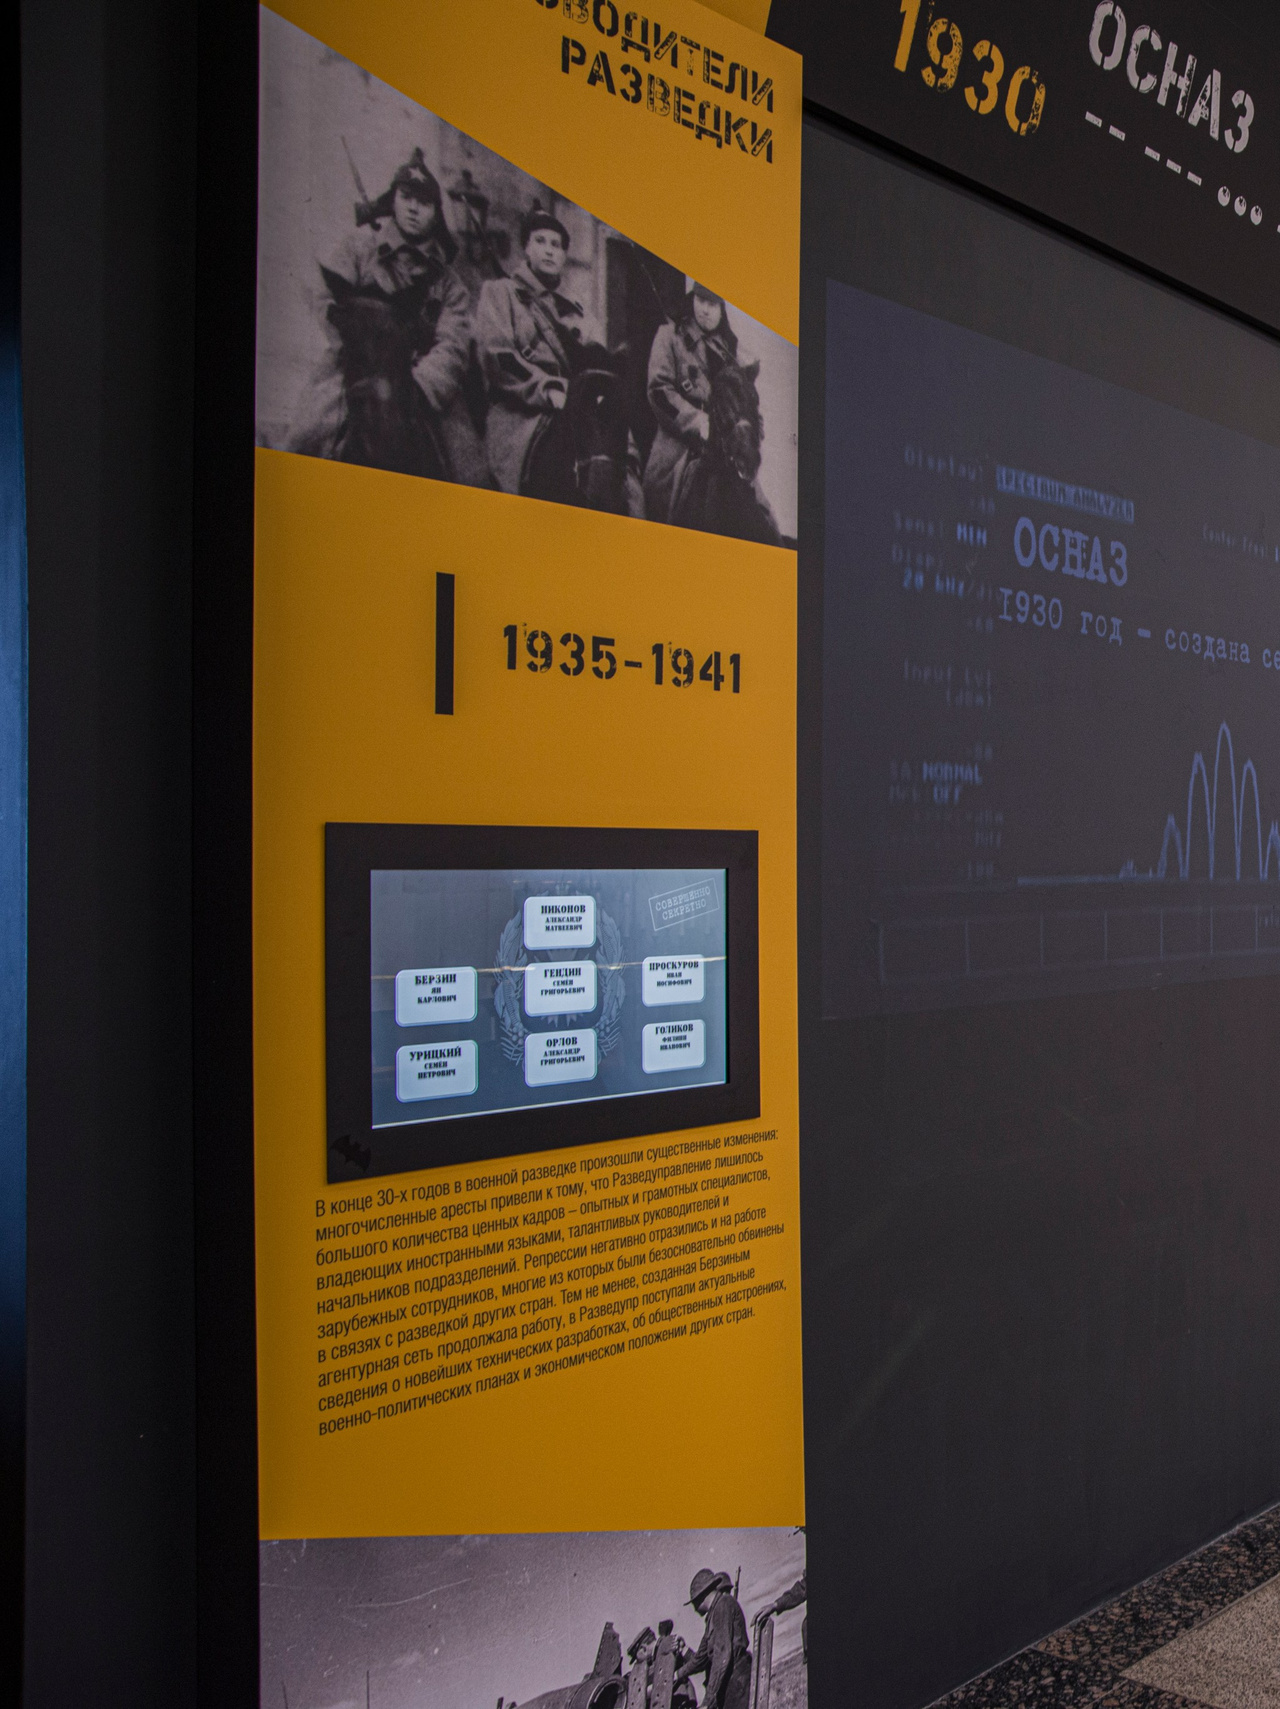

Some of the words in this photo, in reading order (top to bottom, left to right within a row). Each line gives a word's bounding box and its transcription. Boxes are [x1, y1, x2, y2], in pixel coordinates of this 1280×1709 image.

[535, 0, 773, 113] ВОДИТЕЛИ
[894, 0, 1046, 136] 1930
[1088, 1, 1255, 153] ОСНАЗ
[561, 35, 773, 164] РАЗВЕДКИ
[1013, 516, 1129, 587] ОСНАЗ
[998, 587, 1063, 629] 1930
[1080, 611, 1123, 646] год
[1166, 628, 1251, 664] создана
[540, 904, 586, 914] НИКОНОВ
[654, 886, 711, 911] СОВЕРШЕННО
[545, 915, 582, 923] АЛЕКСАНДР
[661, 900, 707, 921] СЕКРЕТНО
[545, 923, 583, 931] МАТВЕЕВИЧ
[543, 967, 582, 978] ГЕНДИН
[649, 961, 699, 971] ПРОСКУРОВ
[666, 971, 682, 979] ИВАН
[415, 973, 457, 985] БЕРЗИН
[417, 995, 457, 1004] КАРЛОВИЧ
[540, 987, 586, 996] ГРИГОРЬЕВИЧ
[655, 1023, 694, 1035] ГОЛИКОВ
[662, 1034, 687, 1043] ФИЛИПП
[543, 1047, 581, 1057] АЛЕКСАНДР
[546, 1036, 578, 1048] ОРЛОВ
[659, 1042, 691, 1051] ИВАНОВИЧ
[409, 1046, 462, 1061] УРИЦКИЙ
[540, 1055, 585, 1066] ГРИГОРЬЕВИЧ
[417, 1069, 456, 1080] ПЕТРОВИЧ
[315, 1199, 326, 1218] В
[330, 1195, 373, 1215] конце
[377, 1188, 408, 1207] 30-х
[411, 1182, 451, 1201] годов
[454, 1180, 462, 1194] в
[465, 1168, 518, 1192] военной
[521, 1161, 577, 1185] разведке
[579, 1150, 644, 1174] произошли
[646, 1137, 721, 1163] существенные
[723, 1129, 779, 1148] изменения:
[315, 1207, 437, 1242] многочисленные
[440, 1199, 487, 1221] аресты
[490, 1189, 543, 1212] привели
[546, 1187, 553, 1200] к
[556, 1182, 587, 1198] тому,
[590, 1177, 610, 1191] что
[612, 1159, 712, 1188] Разведуправление
[714, 1151, 764, 1169] лишилось
[315, 1240, 388, 1266] большого
[392, 1225, 469, 1251] количества
[472, 1215, 519, 1238] ценных
[522, 1206, 566, 1226] кадров
[579, 1194, 630, 1215] опытных
[632, 1192, 639, 1205] и
[642, 1181, 698, 1205] грамотных
[700, 1169, 771, 1191] специалистов,
[316, 1261, 403, 1291] владеющих
[406, 1240, 504, 1272] иностранными
[507, 1229, 565, 1251] языками,
[568, 1213, 640, 1239] талантливых
[643, 1197, 720, 1226] руководителей
[722, 1195, 729, 1207] и
[316, 1283, 410, 1315] начальников
[414, 1258, 520, 1294] подразделений.
[524, 1245, 588, 1270] Репрессии
[590, 1232, 646, 1255] негативно
[648, 1220, 709, 1243] отразились
[711, 1217, 718, 1229] и
[720, 1214, 732, 1227] на
[734, 1207, 767, 1227] работе
[317, 1307, 407, 1339] зарубежных
[411, 1287, 498, 1318] сотрудников,
[501, 1275, 546, 1297] многие
[549, 1271, 564, 1286] из
[567, 1260, 615, 1282] которых
[616, 1253, 646, 1271] были
[648, 1233, 736, 1263] безосновательно
[737, 1222, 784, 1244] обвинены
[317, 1349, 327, 1364] в
[330, 1336, 381, 1360] связях
[385, 1333, 393, 1347] с
[397, 1313, 469, 1348] разведкой
[472, 1304, 516, 1329] других
[519, 1296, 557, 1315] стран.
[562, 1288, 582, 1305] Тем
[585, 1285, 599, 1299] не
[602, 1276, 639, 1295] менее,
[641, 1261, 697, 1286] созданная
[699, 1249, 751, 1272] Берзиным
[318, 1355, 400, 1388] агентурная
[403, 1348, 434, 1366] сеть
[437, 1326, 518, 1359] продолжала
[521, 1315, 566, 1340] работу,
[569, 1312, 577, 1325] в
[579, 1296, 639, 1322] Разведупр
[642, 1282, 696, 1306] поступали
[698, 1267, 755, 1292] актуальные
[318, 1381, 388, 1412] сведения
[392, 1378, 401, 1393] о
[404, 1360, 473, 1389] новейших
[475, 1339, 553, 1370] технических
[556, 1320, 630, 1353] разработках,
[632, 1312, 646, 1329] об
[648, 1295, 723, 1325] общественных
[725, 1279, 787, 1304] настроениях,
[319, 1383, 472, 1436] военно-политических
[475, 1370, 520, 1393] планах
[523, 1367, 531, 1380] и
[534, 1341, 625, 1377] экономическом
[628, 1324, 687, 1351] положении
[689, 1314, 724, 1337] других
[725, 1307, 757, 1324] стран.
